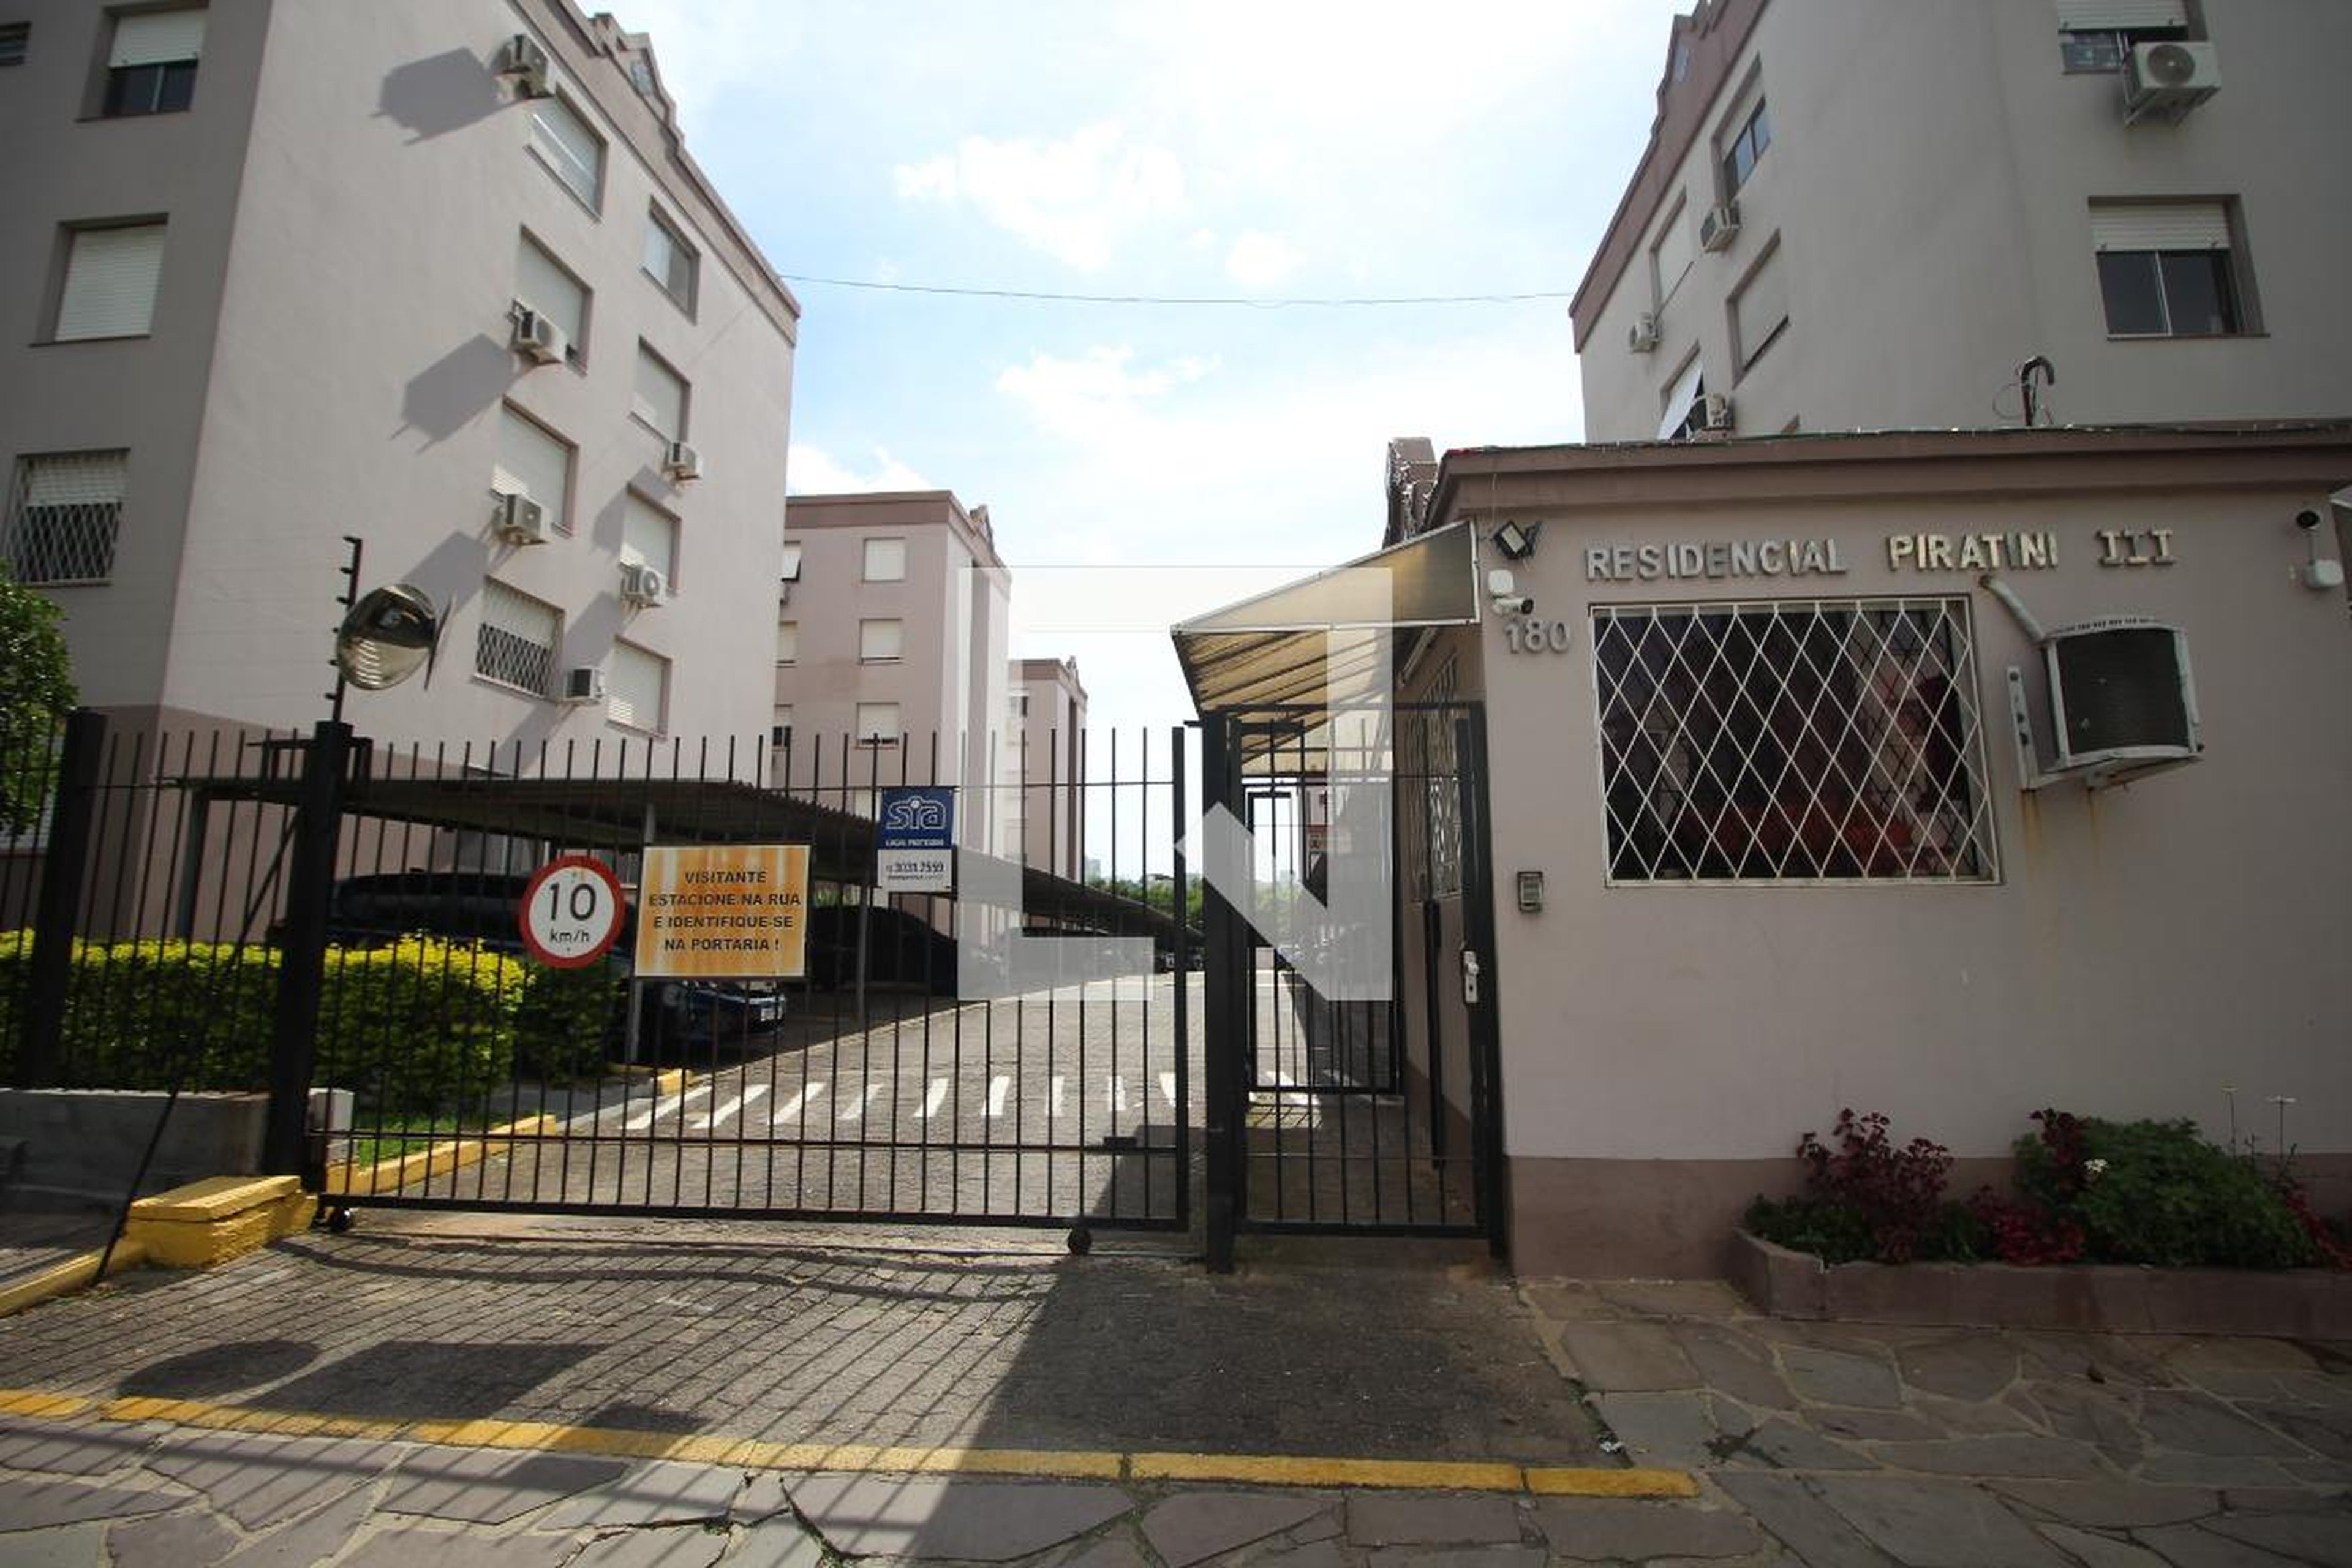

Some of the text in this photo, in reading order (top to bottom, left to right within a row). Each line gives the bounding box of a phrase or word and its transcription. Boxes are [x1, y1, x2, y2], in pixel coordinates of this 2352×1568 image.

[1585, 538, 1847, 582] RESIDENCIAL
[1885, 532, 2060, 571] PIRATINI
[1504, 620, 1571, 654] 180
[685, 871, 767, 884] VISITANTE
[549, 883, 597, 921] 10
[649, 894, 801, 906] ESTACIONE NA RUA
[654, 916, 794, 928] E IDENTIFIQUE-SE
[550, 927, 590, 943] km/h
[665, 938, 685, 950] NA
[692, 938, 770, 950] PORTARIA
